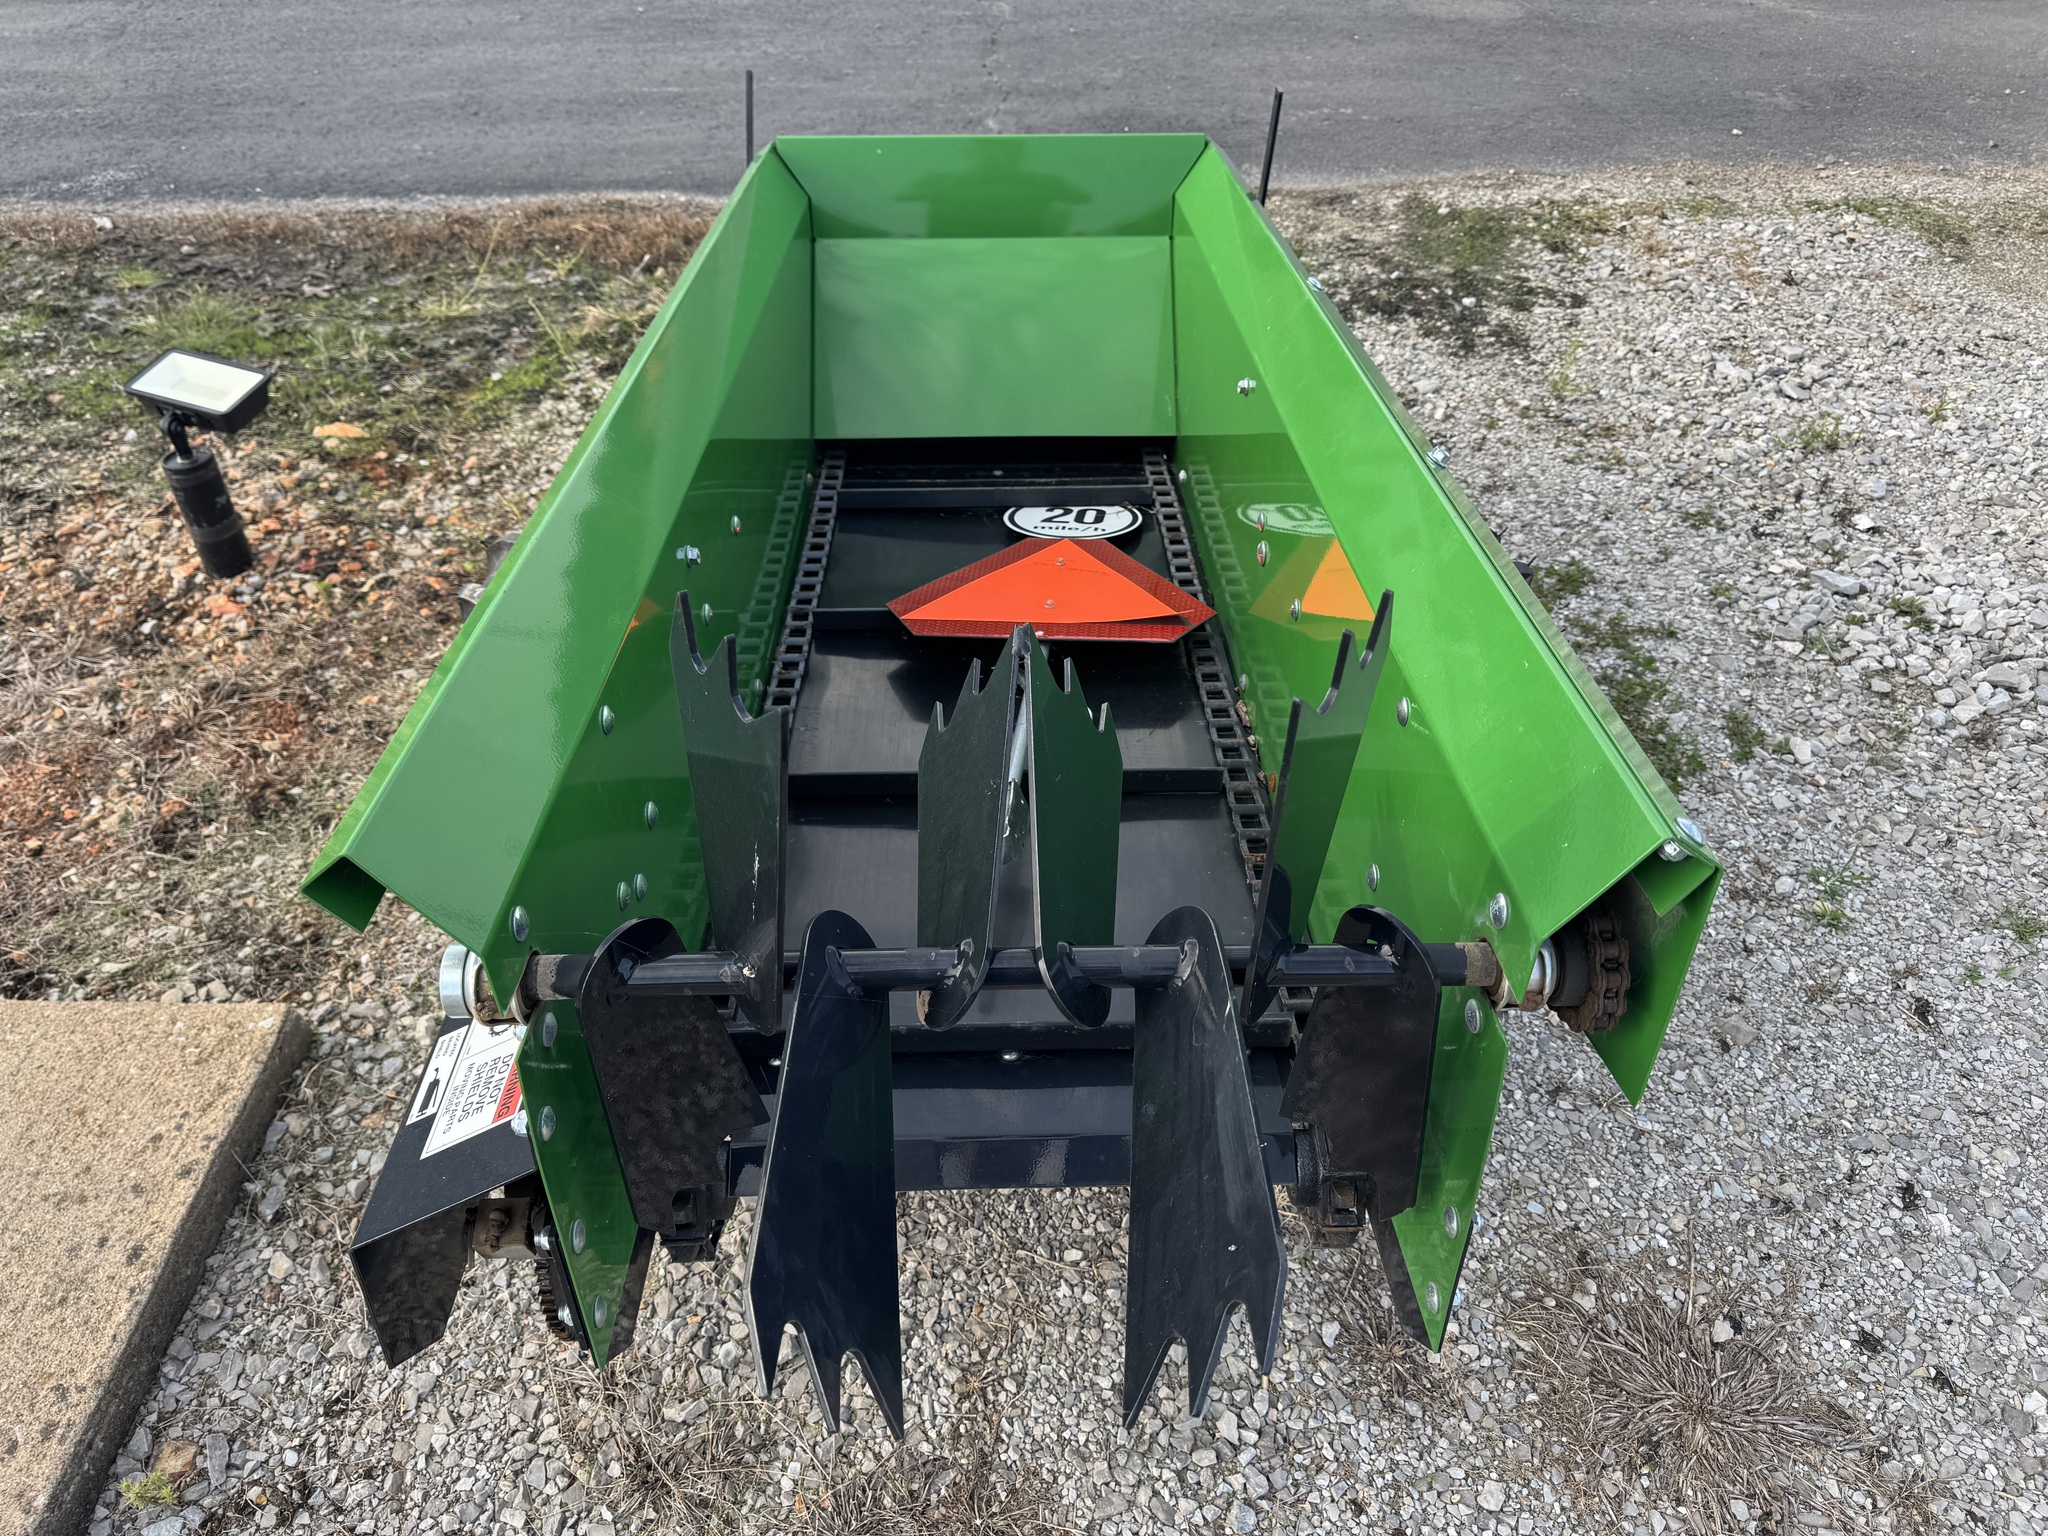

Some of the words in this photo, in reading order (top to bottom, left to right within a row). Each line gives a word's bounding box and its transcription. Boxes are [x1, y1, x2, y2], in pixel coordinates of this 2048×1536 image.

[1040, 507, 1106, 524] 20
[498, 1053, 513, 1074] DO
[456, 1062, 476, 1100] MOVING
[458, 1062, 488, 1122] SHIELDS
[471, 1056, 501, 1117] REMOVE
[487, 1076, 506, 1106] NOT
[442, 1085, 460, 1117] INSIDE
[443, 1101, 461, 1134] PARTS
